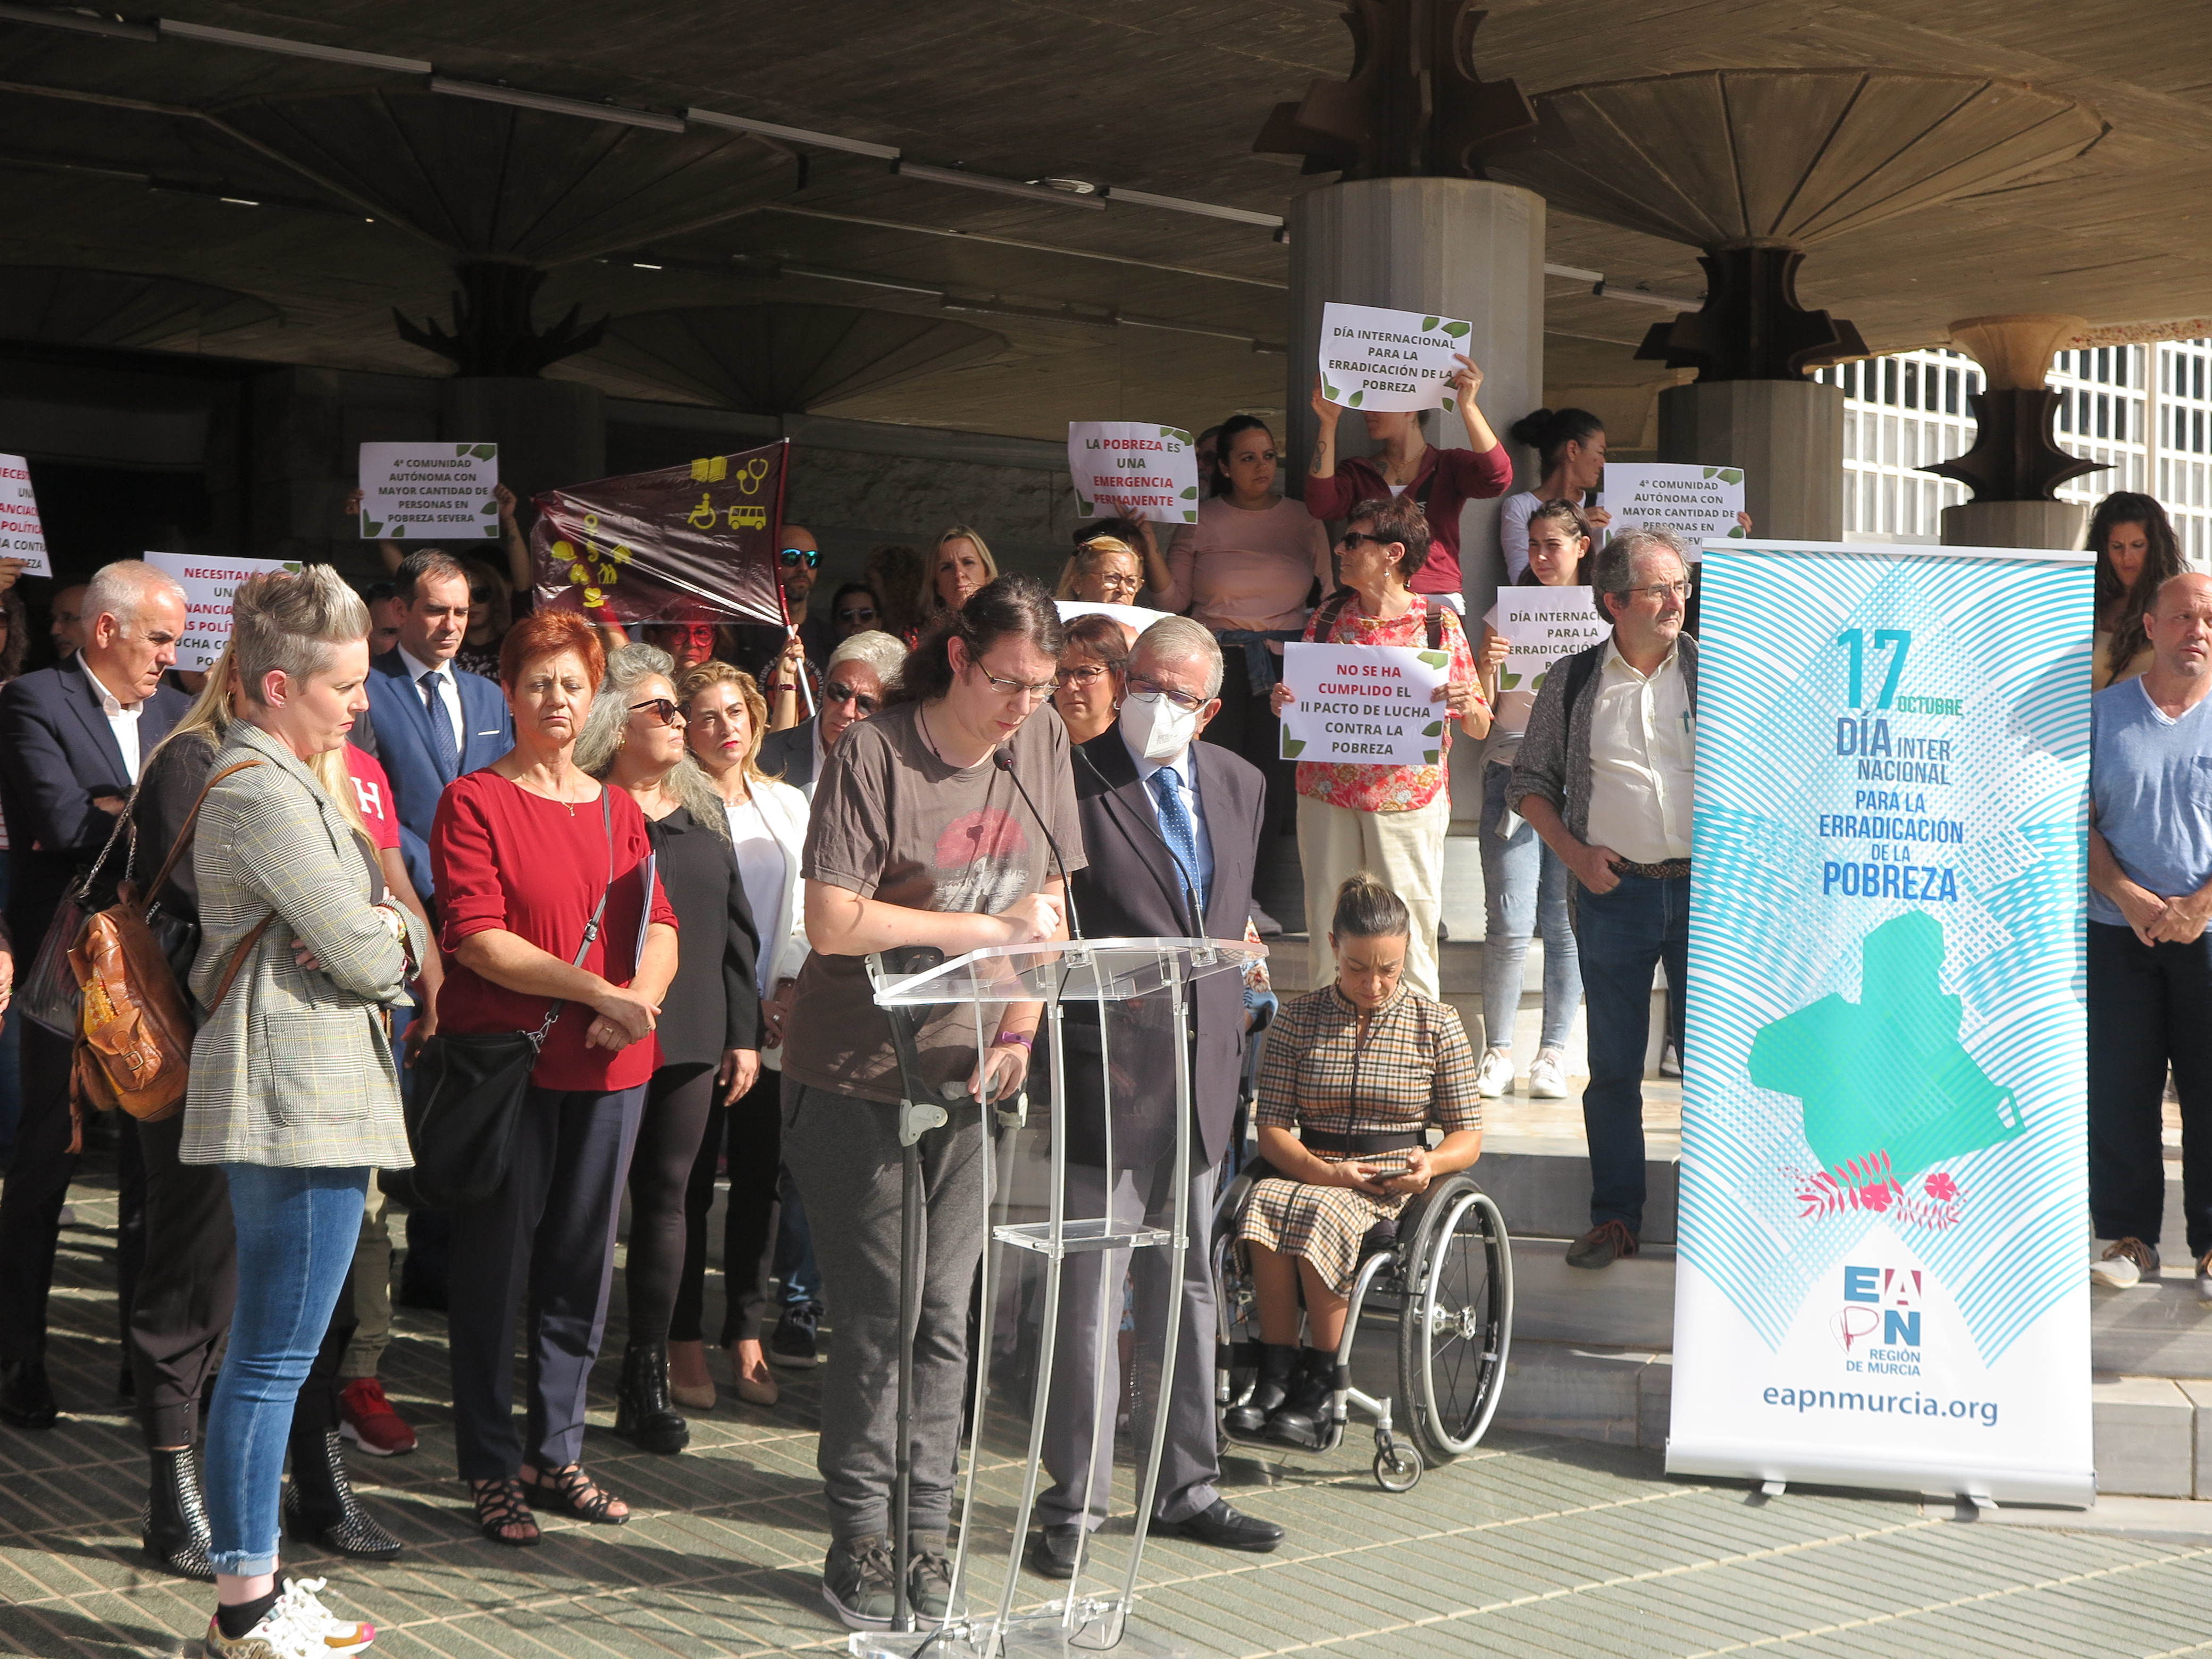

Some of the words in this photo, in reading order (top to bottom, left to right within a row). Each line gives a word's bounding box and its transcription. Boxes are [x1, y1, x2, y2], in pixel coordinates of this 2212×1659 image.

[1334, 326, 1354, 338] DÍA
[1358, 330, 1455, 349] INTERNACIONAL
[1368, 347, 1399, 358] PARA
[1404, 350, 1418, 361] LA
[1329, 359, 1417, 377] ERRADICACIÓN
[1421, 369, 1436, 378] DE
[1439, 370, 1453, 379] LA
[1362, 380, 1417, 393] POBREZA
[1086, 439, 1100, 449] LA
[1103, 439, 1163, 450] POBREZA
[1167, 442, 1180, 453] ES
[1117, 458, 1146, 468] UNA
[389, 471, 451, 481] AUTÓNOMA
[1093, 476, 1174, 488] EMERGENCIA
[1652, 480, 1718, 490] COMUNIDAD
[1093, 494, 1174, 506] PERMANENTE
[1635, 492, 1697, 503] AUTÓNOMA
[1622, 507, 1661, 516] MAYOR
[1665, 508, 1719, 517] CANTIDAD
[1510, 610, 1531, 622] DÍA
[1547, 629, 1579, 638] PARA
[1583, 628, 1598, 636] LA
[1509, 642, 1595, 655] ERRADICACIÓ
[1337, 665, 1358, 675] NO
[1362, 665, 1377, 676] SE
[1381, 667, 1401, 677] HA
[1837, 629, 1912, 709] 17
[1898, 696, 1963, 716] OCTUBRE
[1319, 683, 1392, 697] CUMPLIDO
[1396, 687, 1411, 697] EL
[1301, 701, 1309, 712] II
[1314, 702, 1359, 714] PACTO
[1363, 705, 1379, 715] DE
[1385, 706, 1430, 717] LUCHA
[1325, 722, 1382, 735] CONTRA
[1386, 725, 1403, 736] LA
[1836, 711, 1891, 757] DÍA
[1898, 737, 1950, 761] INTER
[1332, 742, 1393, 755] POBREZA
[1858, 759, 1950, 785] NACIONAL
[350, 776, 384, 820] H
[1856, 791, 1899, 812] PARA
[1905, 793, 1925, 813] LA
[1819, 814, 1963, 844] ERRADICACIÓN
[1871, 843, 1891, 861] DE
[1894, 844, 1911, 863] LA
[1823, 861, 1957, 903] POBREZA
[1870, 1348, 1921, 1363] REGIÓN
[1846, 1360, 1864, 1373] DE
[1867, 1361, 1921, 1377] MURCIA
[1763, 1386, 1998, 1427] eapnmurcia.org
